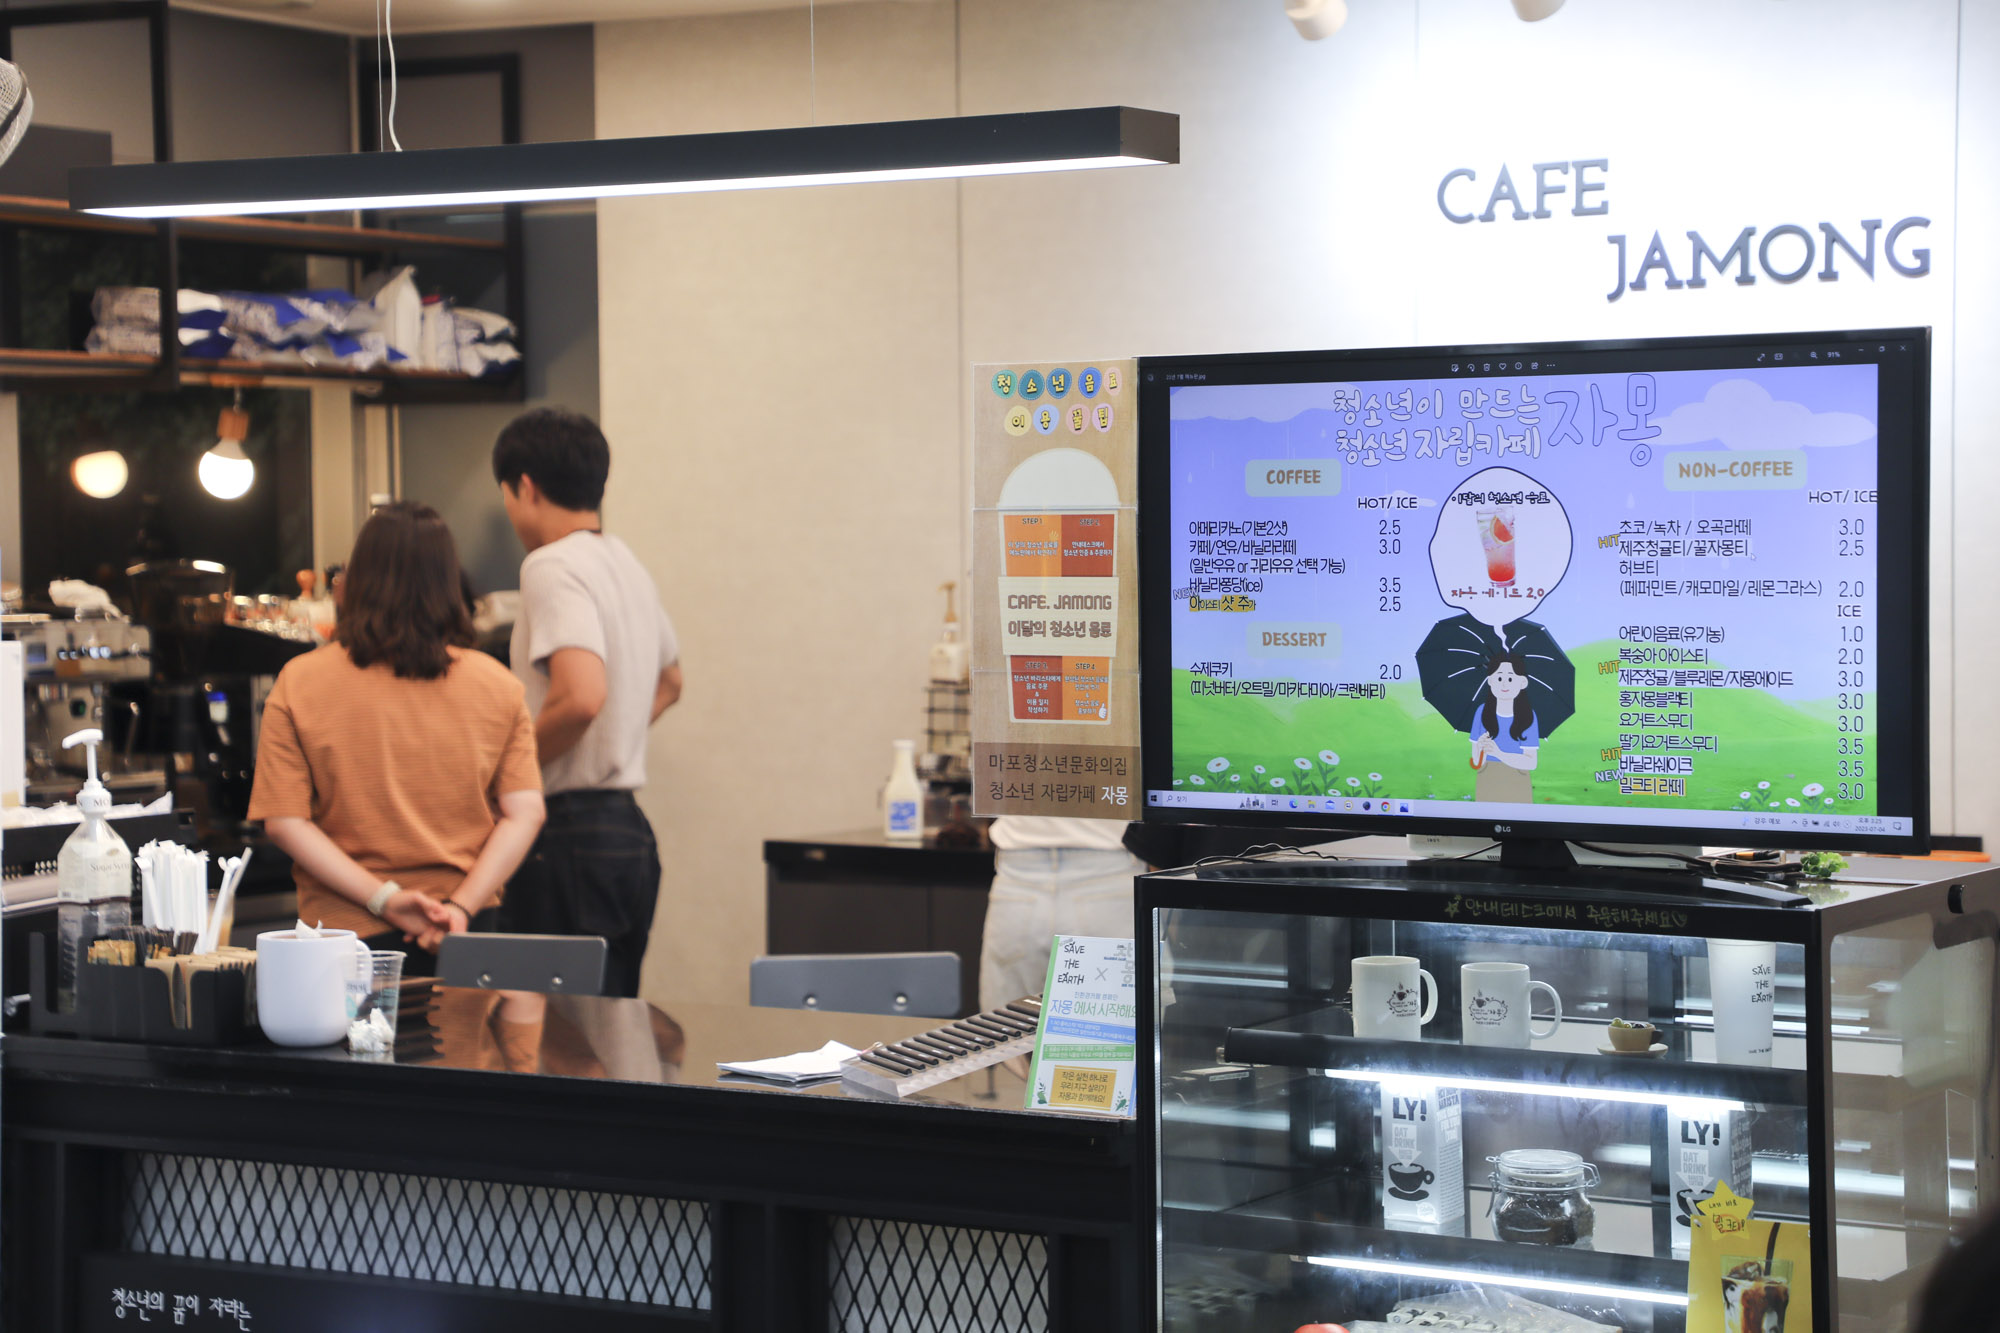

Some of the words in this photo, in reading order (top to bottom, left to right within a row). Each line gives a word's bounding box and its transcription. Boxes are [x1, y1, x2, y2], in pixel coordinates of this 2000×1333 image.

[1437, 159, 1609, 225] CAFE
[1607, 216, 1932, 303] JAMONG
[997, 374, 1065, 394] 청소년
[1333, 387, 1444, 428] 청소년이
[1459, 383, 1541, 425] 만드는
[1012, 410, 1051, 430] 이용
[1544, 373, 1662, 467] 자몽
[1335, 428, 1408, 467] 청소년
[1413, 420, 1541, 467] 자립카페
[1266, 469, 1321, 484] COFFEE
[1678, 461, 1794, 479] NON-COFFEE
[1396, 496, 1418, 509] ICE
[1487, 491, 1524, 505] 청소년
[1189, 520, 1288, 537] 아메리카노(기본2샷)
[1379, 519, 1401, 535] 2.5
[1619, 520, 1681, 536] 초코/녹차
[1696, 519, 1752, 536] 오곡라떼
[1839, 519, 1864, 535] 3.0
[1189, 539, 1297, 556] 카페/연유/바닐라라떼
[1379, 539, 1401, 555] 3.0
[1598, 534, 1620, 549] HIT
[1619, 540, 1749, 557] 제주청귤티/꿀자몽티
[1839, 540, 1864, 556] 2.5
[1189, 558, 1236, 574] (일반우유
[1237, 563, 1248, 574] or
[1250, 558, 1294, 574] 귀리우유
[1295, 558, 1318, 574] 선택
[1320, 558, 1346, 574] 가능)
[1619, 560, 1659, 577] 허브티
[1189, 577, 1264, 593] 바닐라퐁당(ice)
[1379, 577, 1401, 593] 3.5
[1619, 580, 1823, 598] (페퍼민트/캐모마일/레몬그라스)
[1839, 581, 1864, 598] 2.0
[1173, 588, 1199, 600] NEW
[1526, 587, 1545, 600] 2.0
[1053, 595, 1112, 610] JAMONG
[1379, 597, 1401, 611] 2.5
[1837, 605, 1861, 617] ICE
[1008, 620, 1046, 637] 이달의
[1050, 620, 1086, 638] 청소년
[1089, 621, 1111, 638] 음료
[1619, 626, 1725, 643] 어린이음료(유기농)
[1840, 627, 1864, 642] 1.0
[1262, 632, 1327, 647] DESSERT
[1619, 648, 1656, 664] 복숭아
[1658, 648, 1708, 665] 아이스티
[1838, 649, 1864, 665] 2.0
[1190, 662, 1233, 677] 수제쿠키
[1379, 665, 1402, 680] 2.0
[1598, 660, 1620, 674] HIT
[1838, 671, 1864, 687] 3.0
[1619, 691, 1693, 708] 홍자몽블랙티
[1838, 693, 1864, 709] 3.0
[1619, 712, 1693, 730] 요거트스무디
[1838, 715, 1864, 732] 3.0
[1619, 734, 1717, 752] 딸기요거트스무디
[1838, 738, 1864, 754] 3.5
[1601, 747, 1623, 761] HIT
[989, 755, 1127, 776] 마포청소년문화의집
[1619, 756, 1693, 773] 바닐라쉐이크
[1838, 760, 1864, 777] 3.5
[1595, 769, 1624, 783] NEW
[990, 782, 1034, 800] 청소년
[1041, 784, 1095, 803] 자립카페
[1101, 786, 1128, 805] 자몽
[1619, 777, 1656, 795] 밀크티
[1659, 778, 1684, 795] 라떼
[1838, 783, 1864, 799] 3.0
[1064, 942, 1085, 954] SAVE
[1064, 958, 1080, 969] THE
[1752, 964, 1771, 976] SAVE
[1057, 973, 1085, 985] EARTH
[1755, 980, 1769, 989] THE
[1050, 999, 1072, 1015] 자몽
[1074, 1001, 1096, 1016] 에서
[1393, 1096, 1427, 1121] LY!
[1681, 1120, 1720, 1146] LY!
[112, 1288, 164, 1321] 청소년의
[209, 1297, 252, 1331] 자라는
